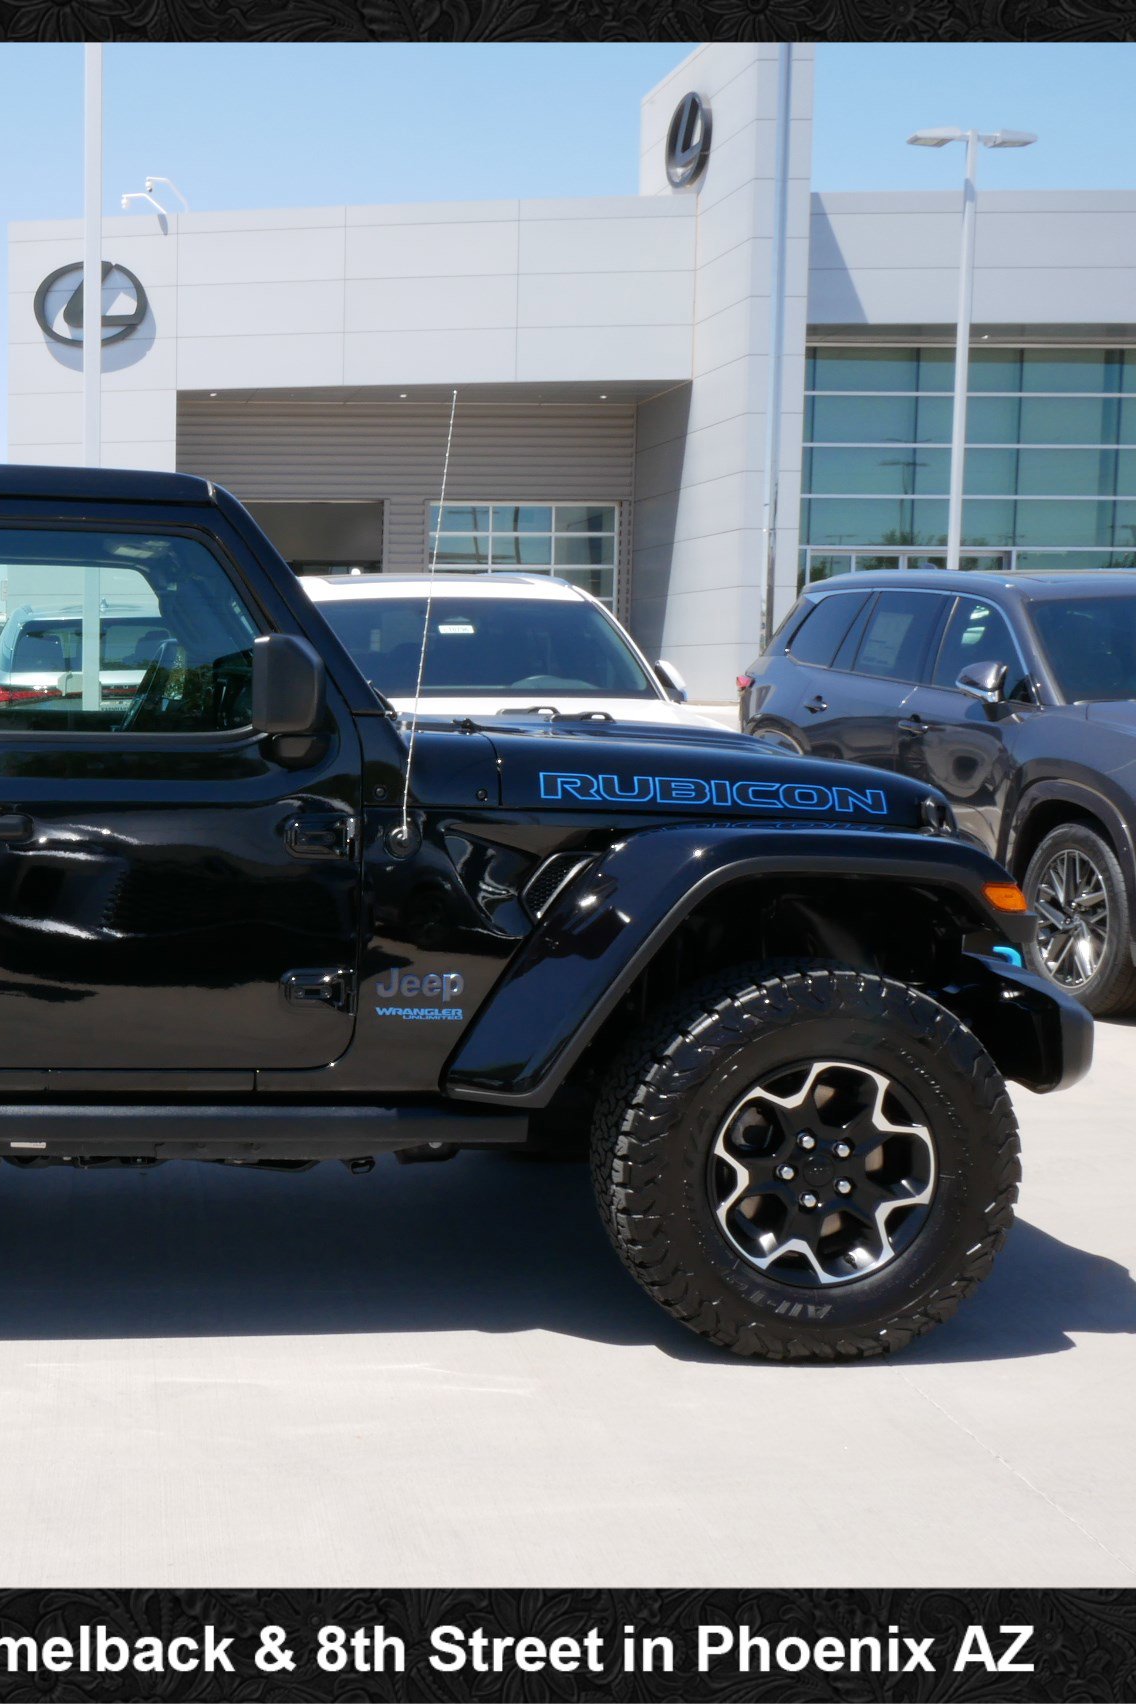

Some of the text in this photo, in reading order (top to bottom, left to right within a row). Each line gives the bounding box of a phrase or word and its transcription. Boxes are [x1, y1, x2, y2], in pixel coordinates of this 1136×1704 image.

[538, 771, 888, 815] RUBICON
[375, 967, 464, 1002] Jeep
[375, 1006, 463, 1016] WRANGLER
